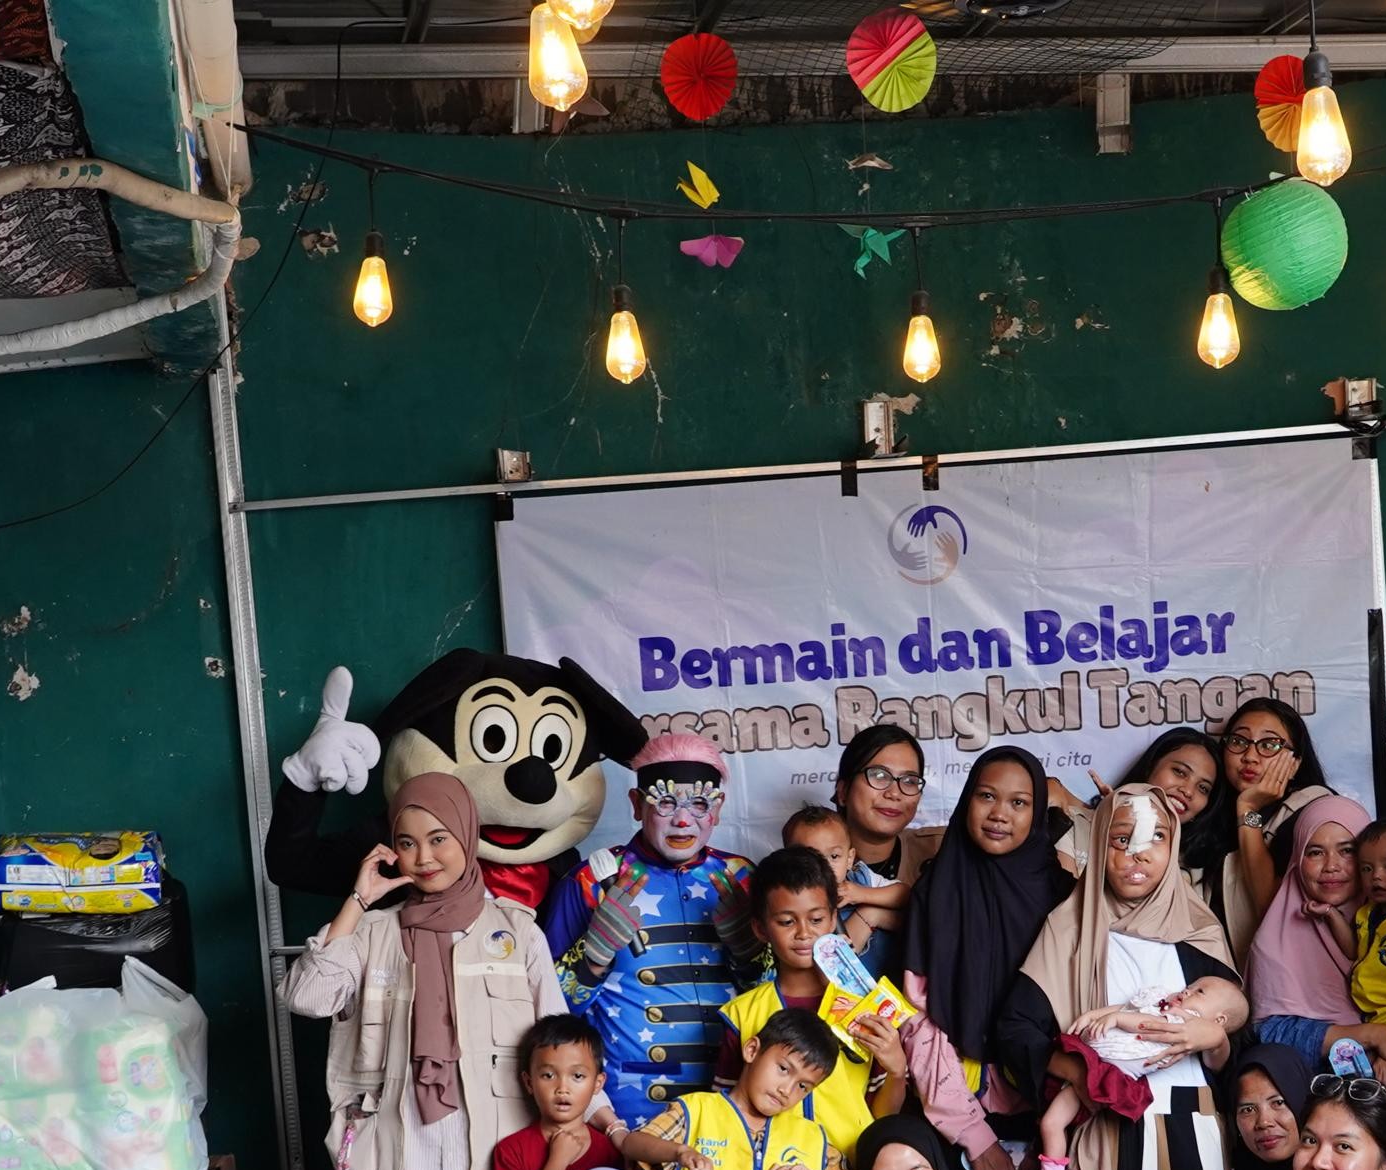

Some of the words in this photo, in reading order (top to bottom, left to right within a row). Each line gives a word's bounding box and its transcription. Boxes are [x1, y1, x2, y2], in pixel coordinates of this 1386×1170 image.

[638, 622, 887, 692] Bermain
[898, 617, 1012, 674] dan
[1024, 601, 1235, 672] Belajar
[640, 703, 830, 753] rsama
[835, 670, 1082, 752] Rangkul
[1087, 668, 1316, 734] Tangan
[1057, 752, 1093, 767] cita
